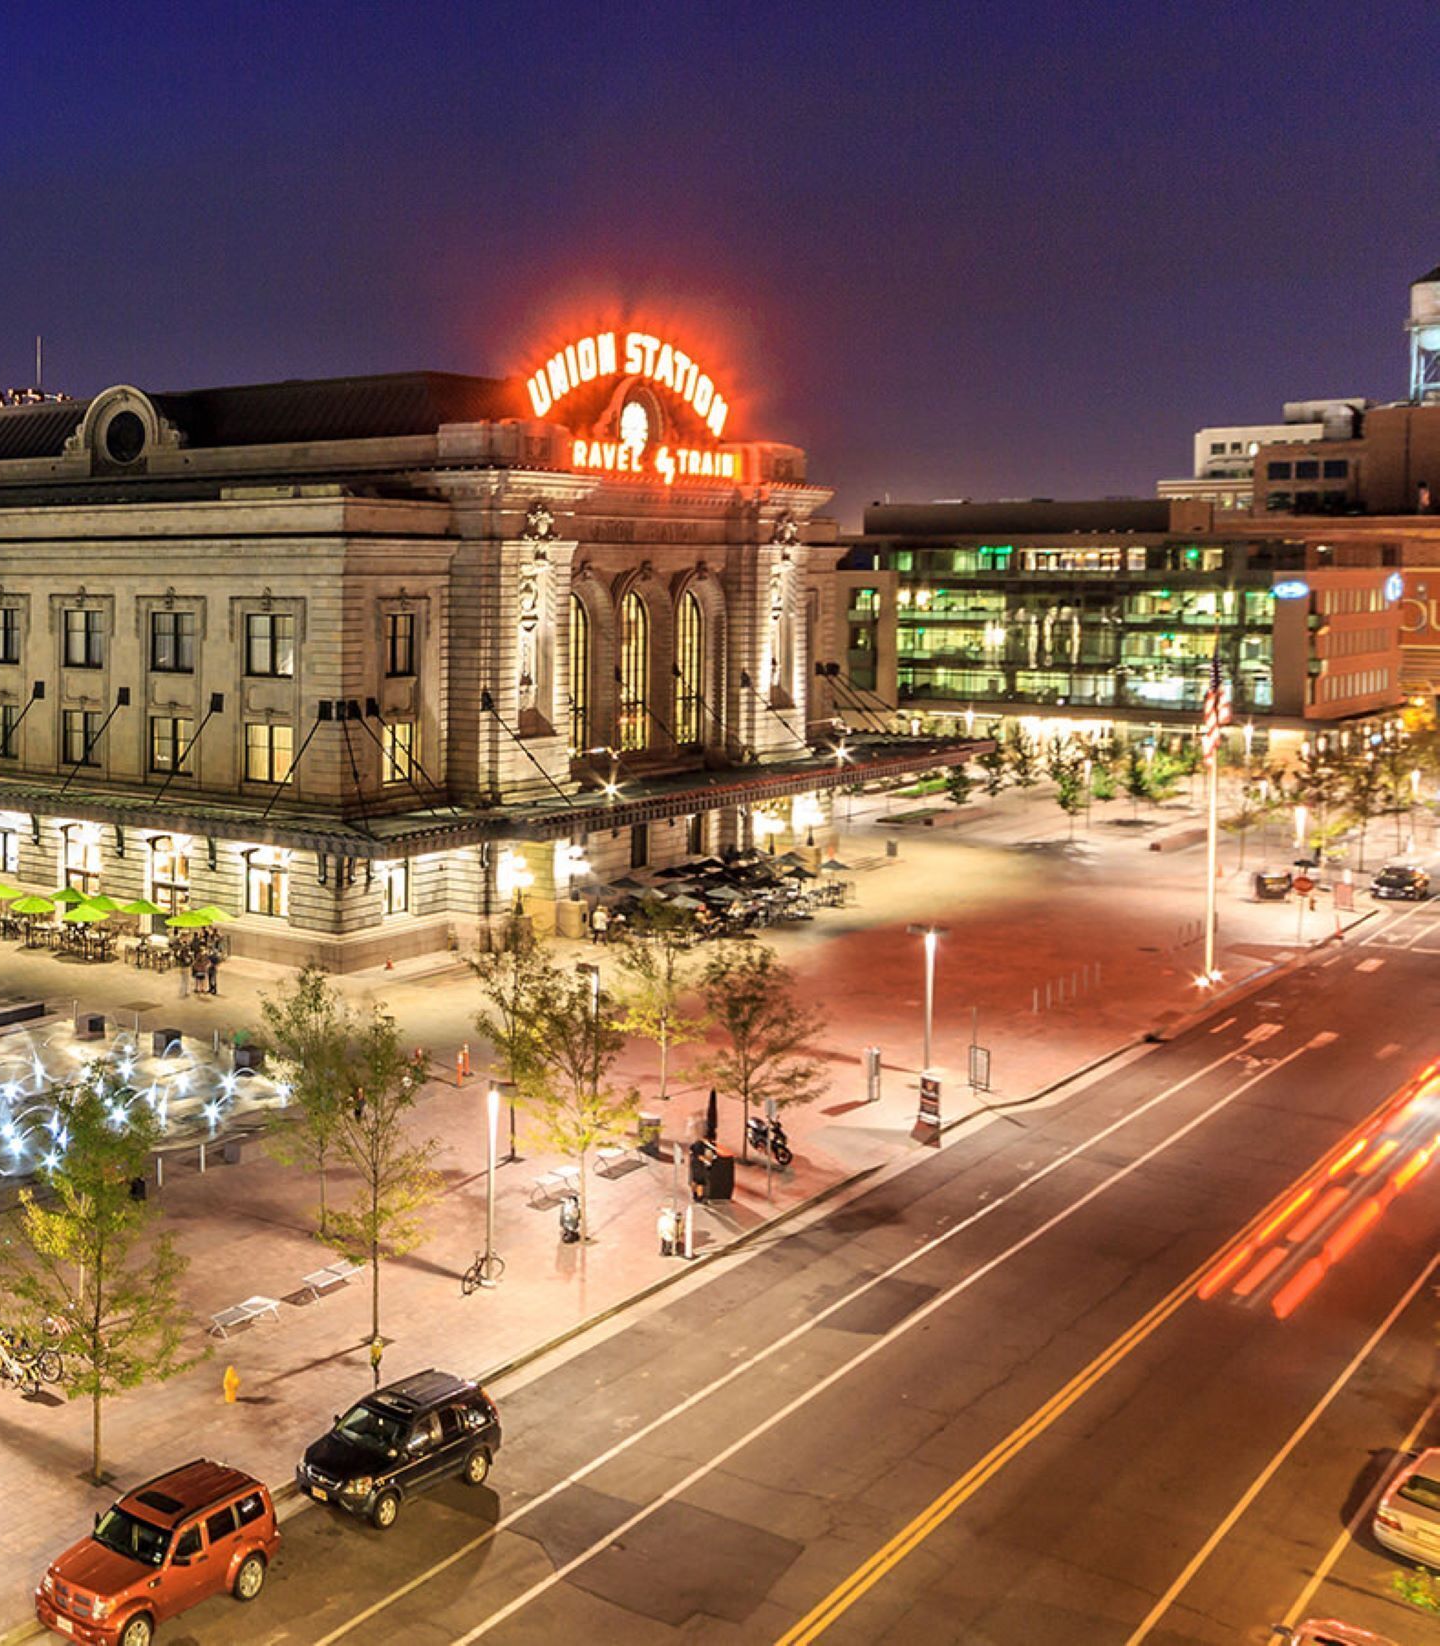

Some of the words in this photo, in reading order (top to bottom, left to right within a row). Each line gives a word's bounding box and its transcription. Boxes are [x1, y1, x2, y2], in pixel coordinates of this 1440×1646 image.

[526, 331, 617, 418] UNION
[623, 331, 729, 438] STATION
[676, 449, 735, 478] TRAIN
